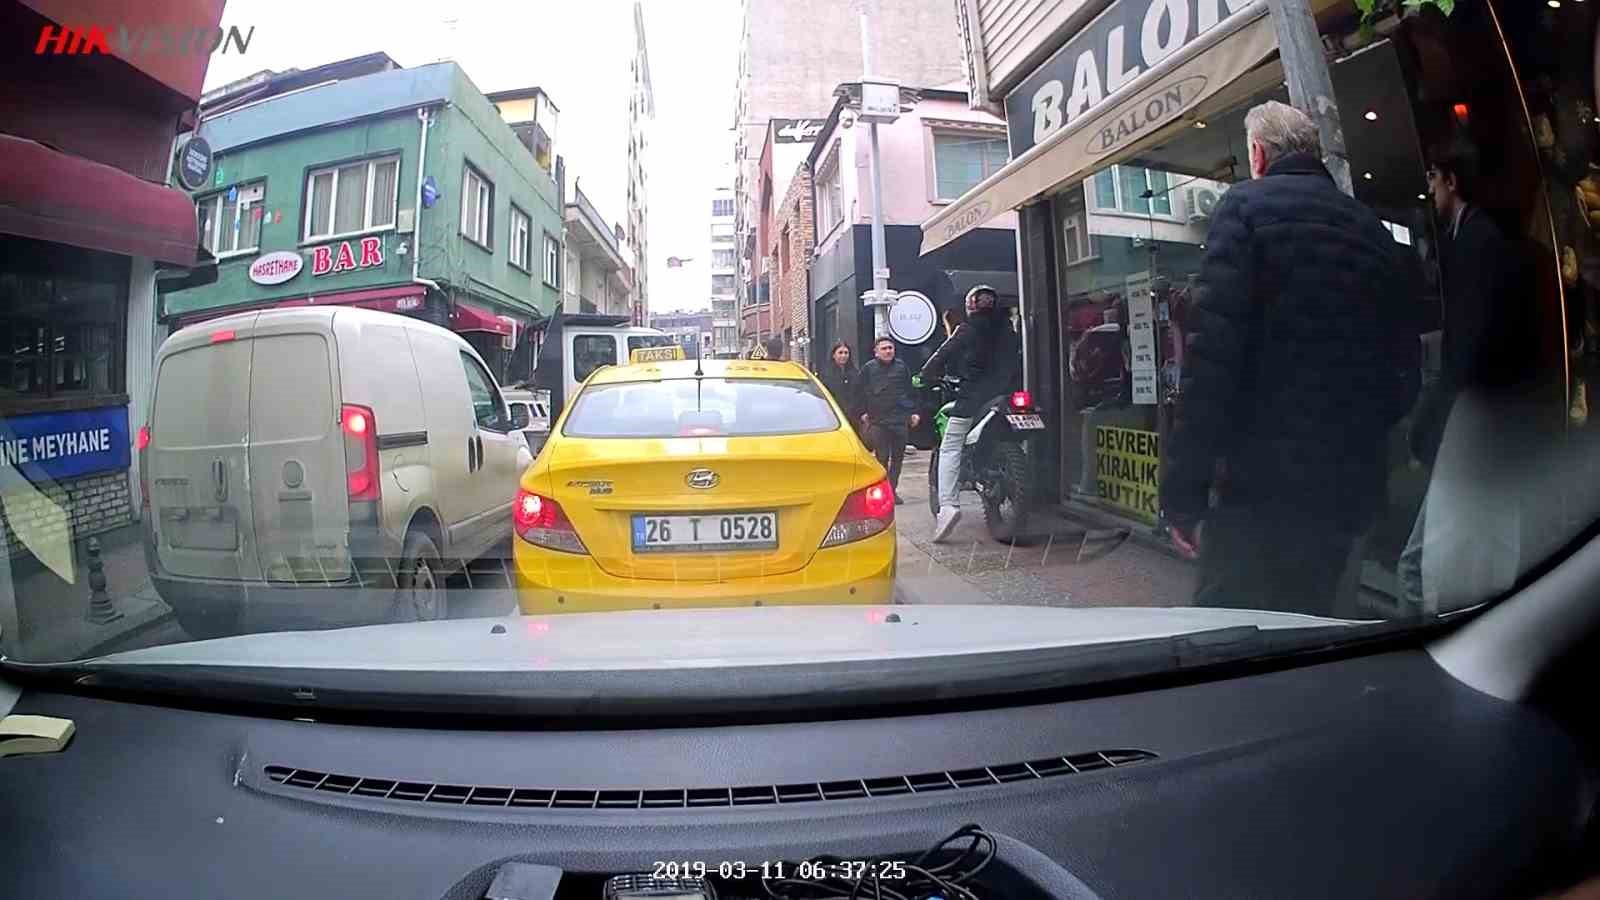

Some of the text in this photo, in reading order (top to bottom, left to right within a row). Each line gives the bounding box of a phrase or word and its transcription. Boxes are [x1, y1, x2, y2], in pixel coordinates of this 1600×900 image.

[1100, 84, 1184, 150] BALON
[312, 237, 383, 275] BAR
[33, 428, 110, 460] MEYHANE
[1097, 428, 1159, 457] DEVREN
[1097, 453, 1158, 487] KIRALIK
[1098, 480, 1157, 513] BUTİK
[646, 519, 672, 542] 26
[690, 518, 701, 541] T
[720, 516, 772, 540] 0528
